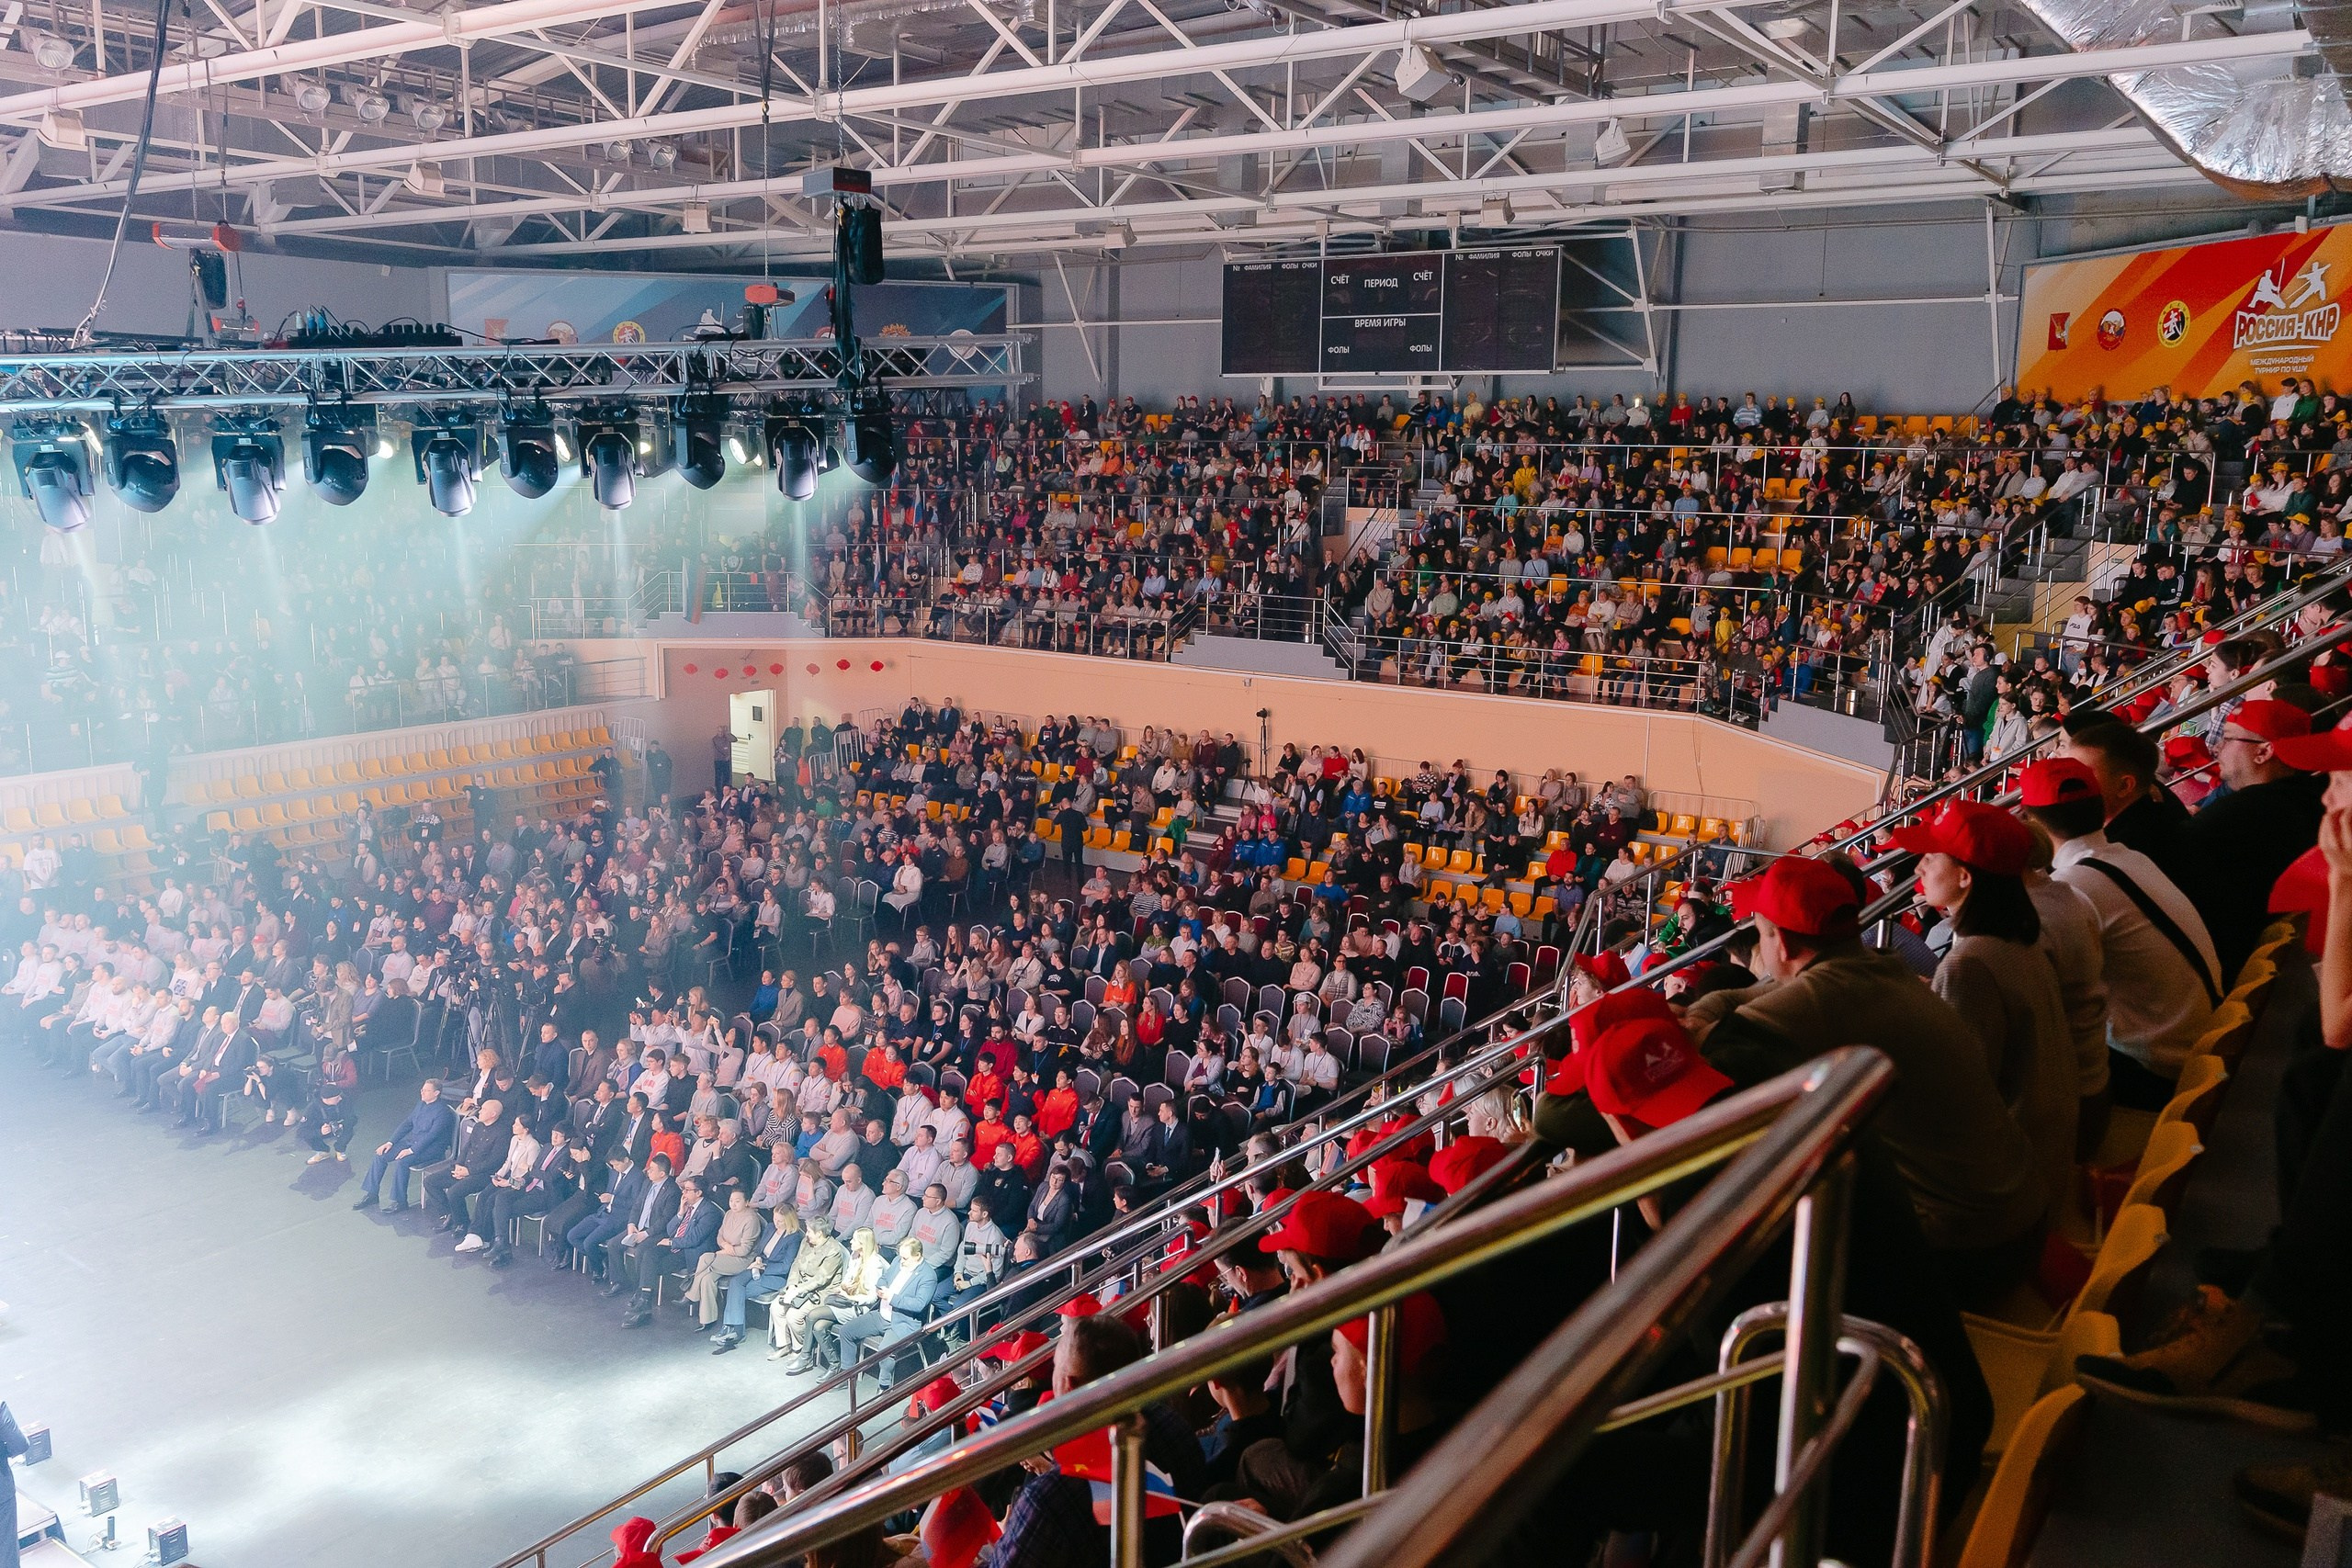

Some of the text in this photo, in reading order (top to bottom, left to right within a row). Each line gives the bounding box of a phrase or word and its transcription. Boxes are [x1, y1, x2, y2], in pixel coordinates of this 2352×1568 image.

[1330, 274, 1350, 285] СЧЁТ
[1413, 270, 1433, 281] СЧЁТ
[1364, 278, 1398, 288] ПЕРИОД
[1354, 318, 1407, 328] ВРЕМЯ ИГРЫ
[2233, 303, 2340, 349] РОССИЯ-КНР
[2250, 355, 2314, 366] МЕЖДУНАРОДНЫЙ
